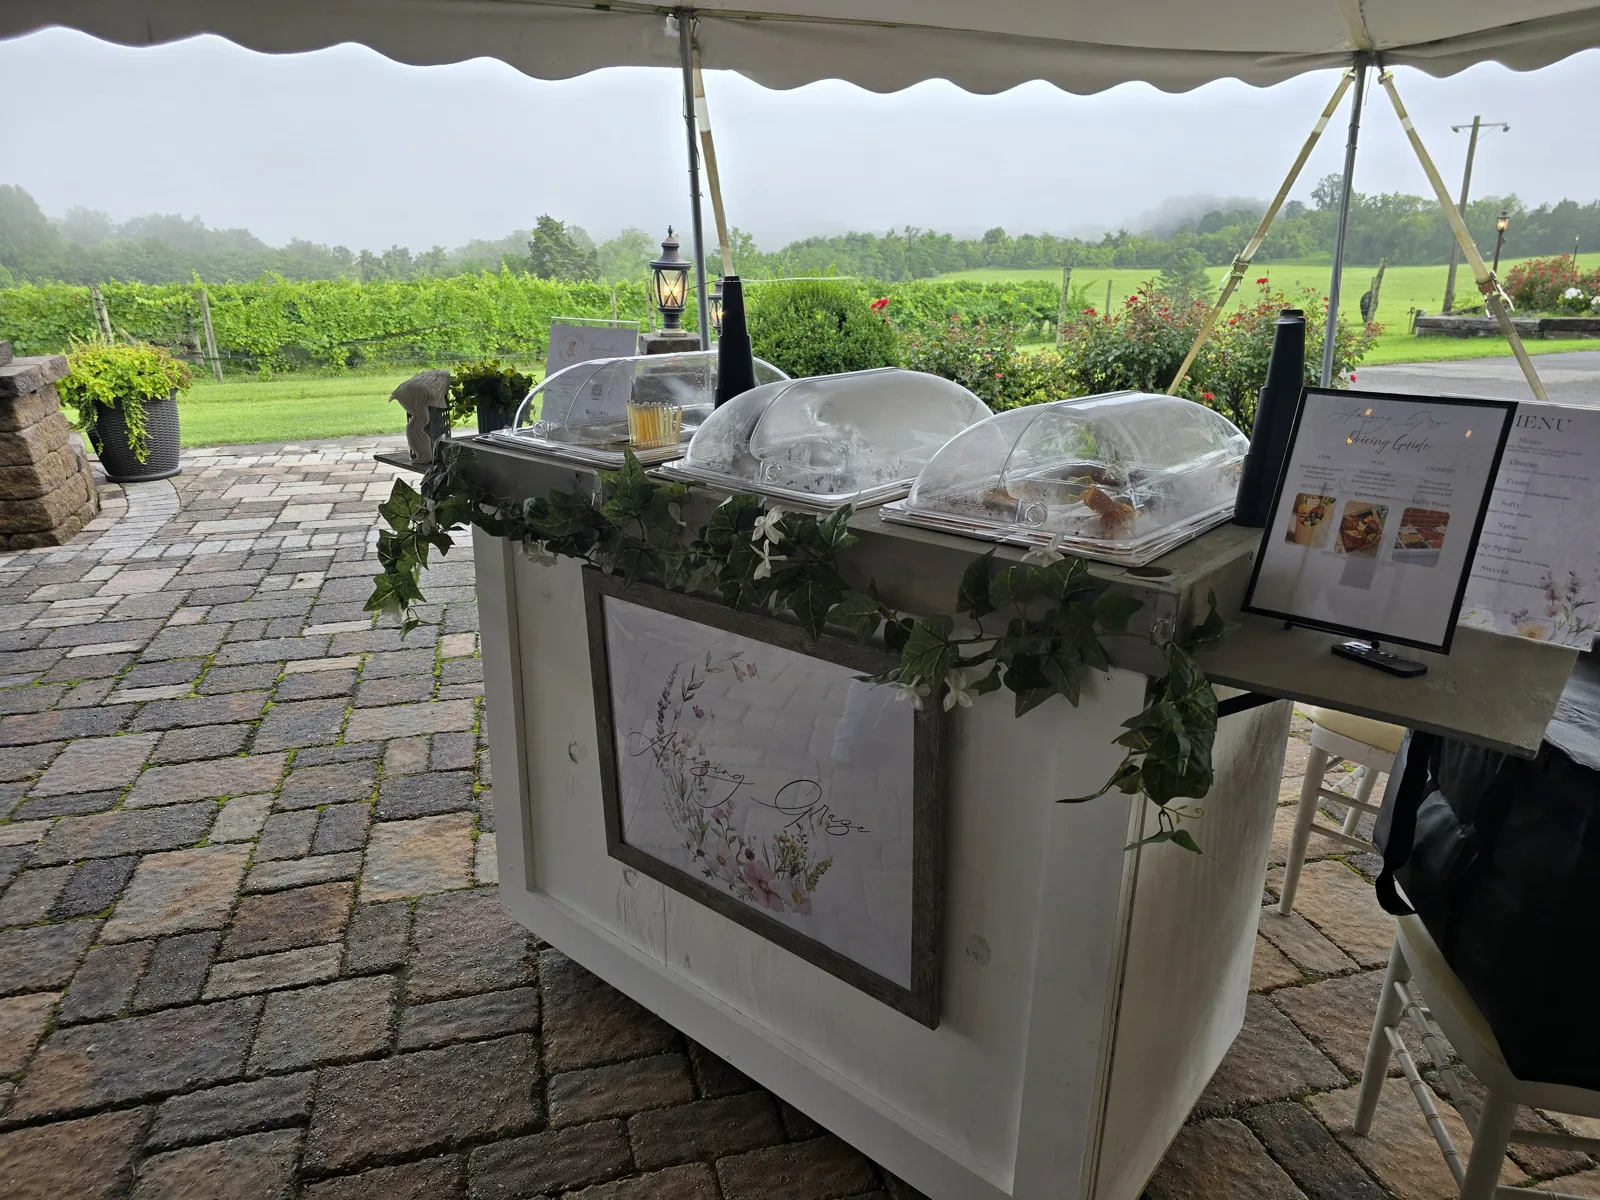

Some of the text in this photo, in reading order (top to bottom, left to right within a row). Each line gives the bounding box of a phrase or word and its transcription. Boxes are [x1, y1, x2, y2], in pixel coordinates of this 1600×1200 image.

[1346, 429, 1432, 454] Pricing Guide
[1518, 437, 1542, 445] Meats
[1509, 459, 1538, 468] Cheese
[1425, 466, 1456, 474] UNLIMITED
[1505, 477, 1530, 487] Fruits
[1431, 500, 1451, 508] Person
[1500, 500, 1522, 509] Salty
[1496, 522, 1516, 530] Nuts
[1493, 543, 1522, 554] Spread
[1480, 564, 1509, 576] Sweets
[626, 731, 871, 836] Amazing Graze
